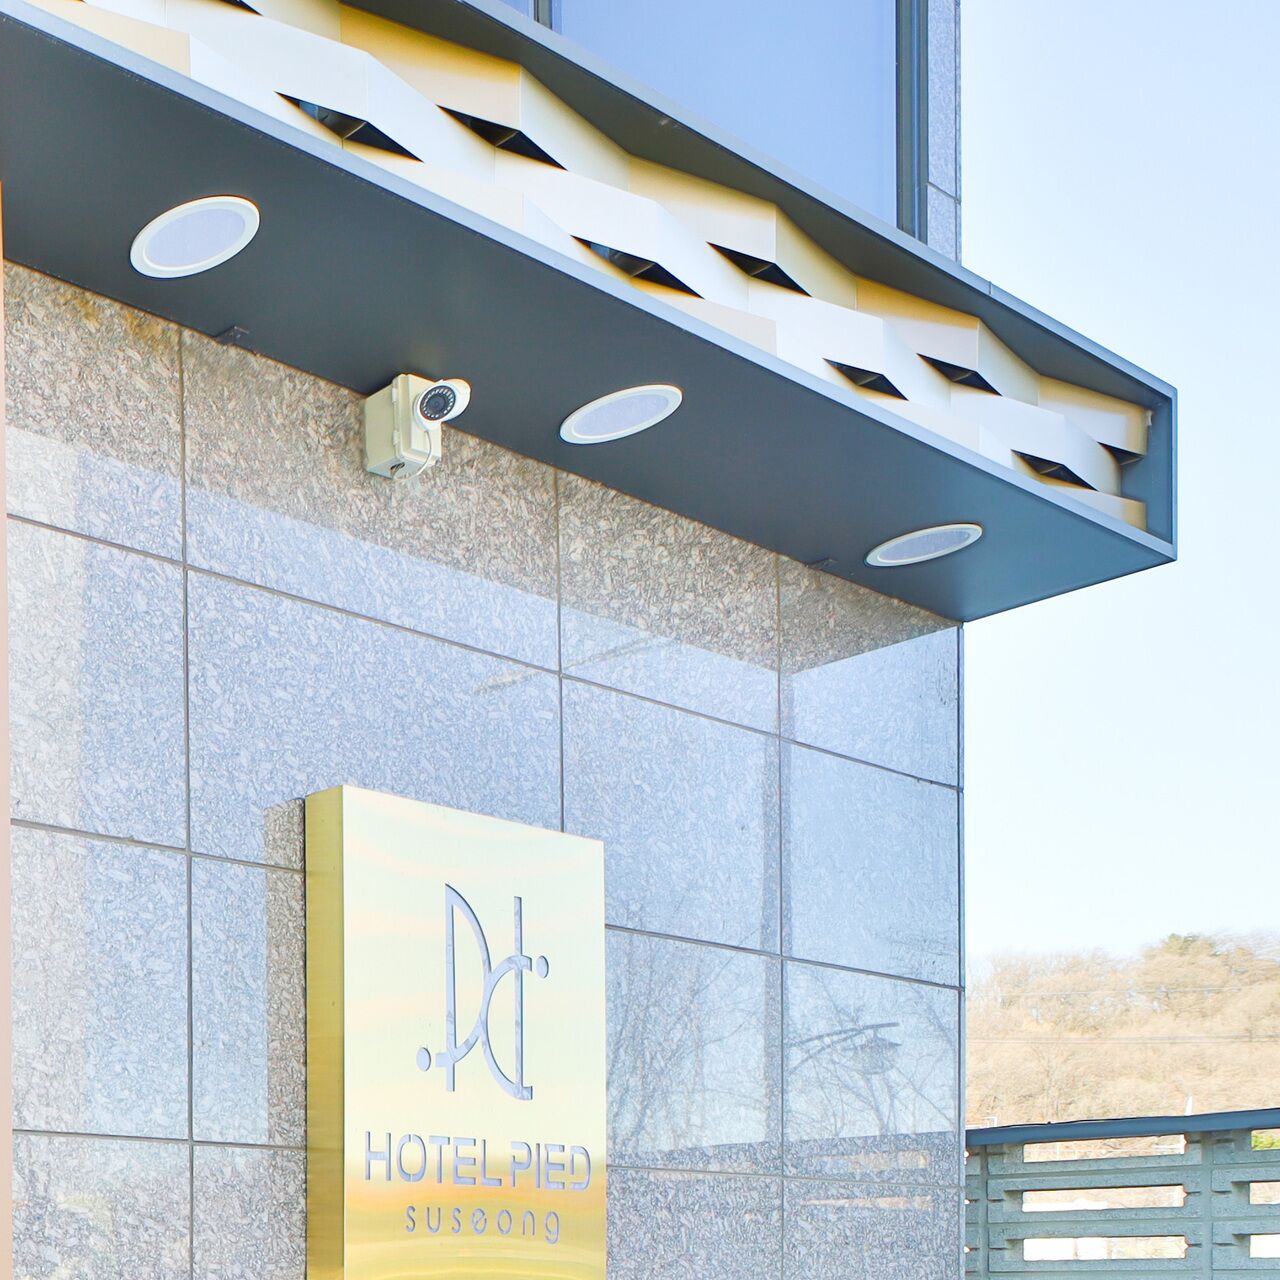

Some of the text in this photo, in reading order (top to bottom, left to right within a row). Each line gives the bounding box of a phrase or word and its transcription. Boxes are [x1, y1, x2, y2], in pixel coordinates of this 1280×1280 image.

[364, 1131, 592, 1192] HOTEL PIED
[405, 1204, 561, 1245] suseong
